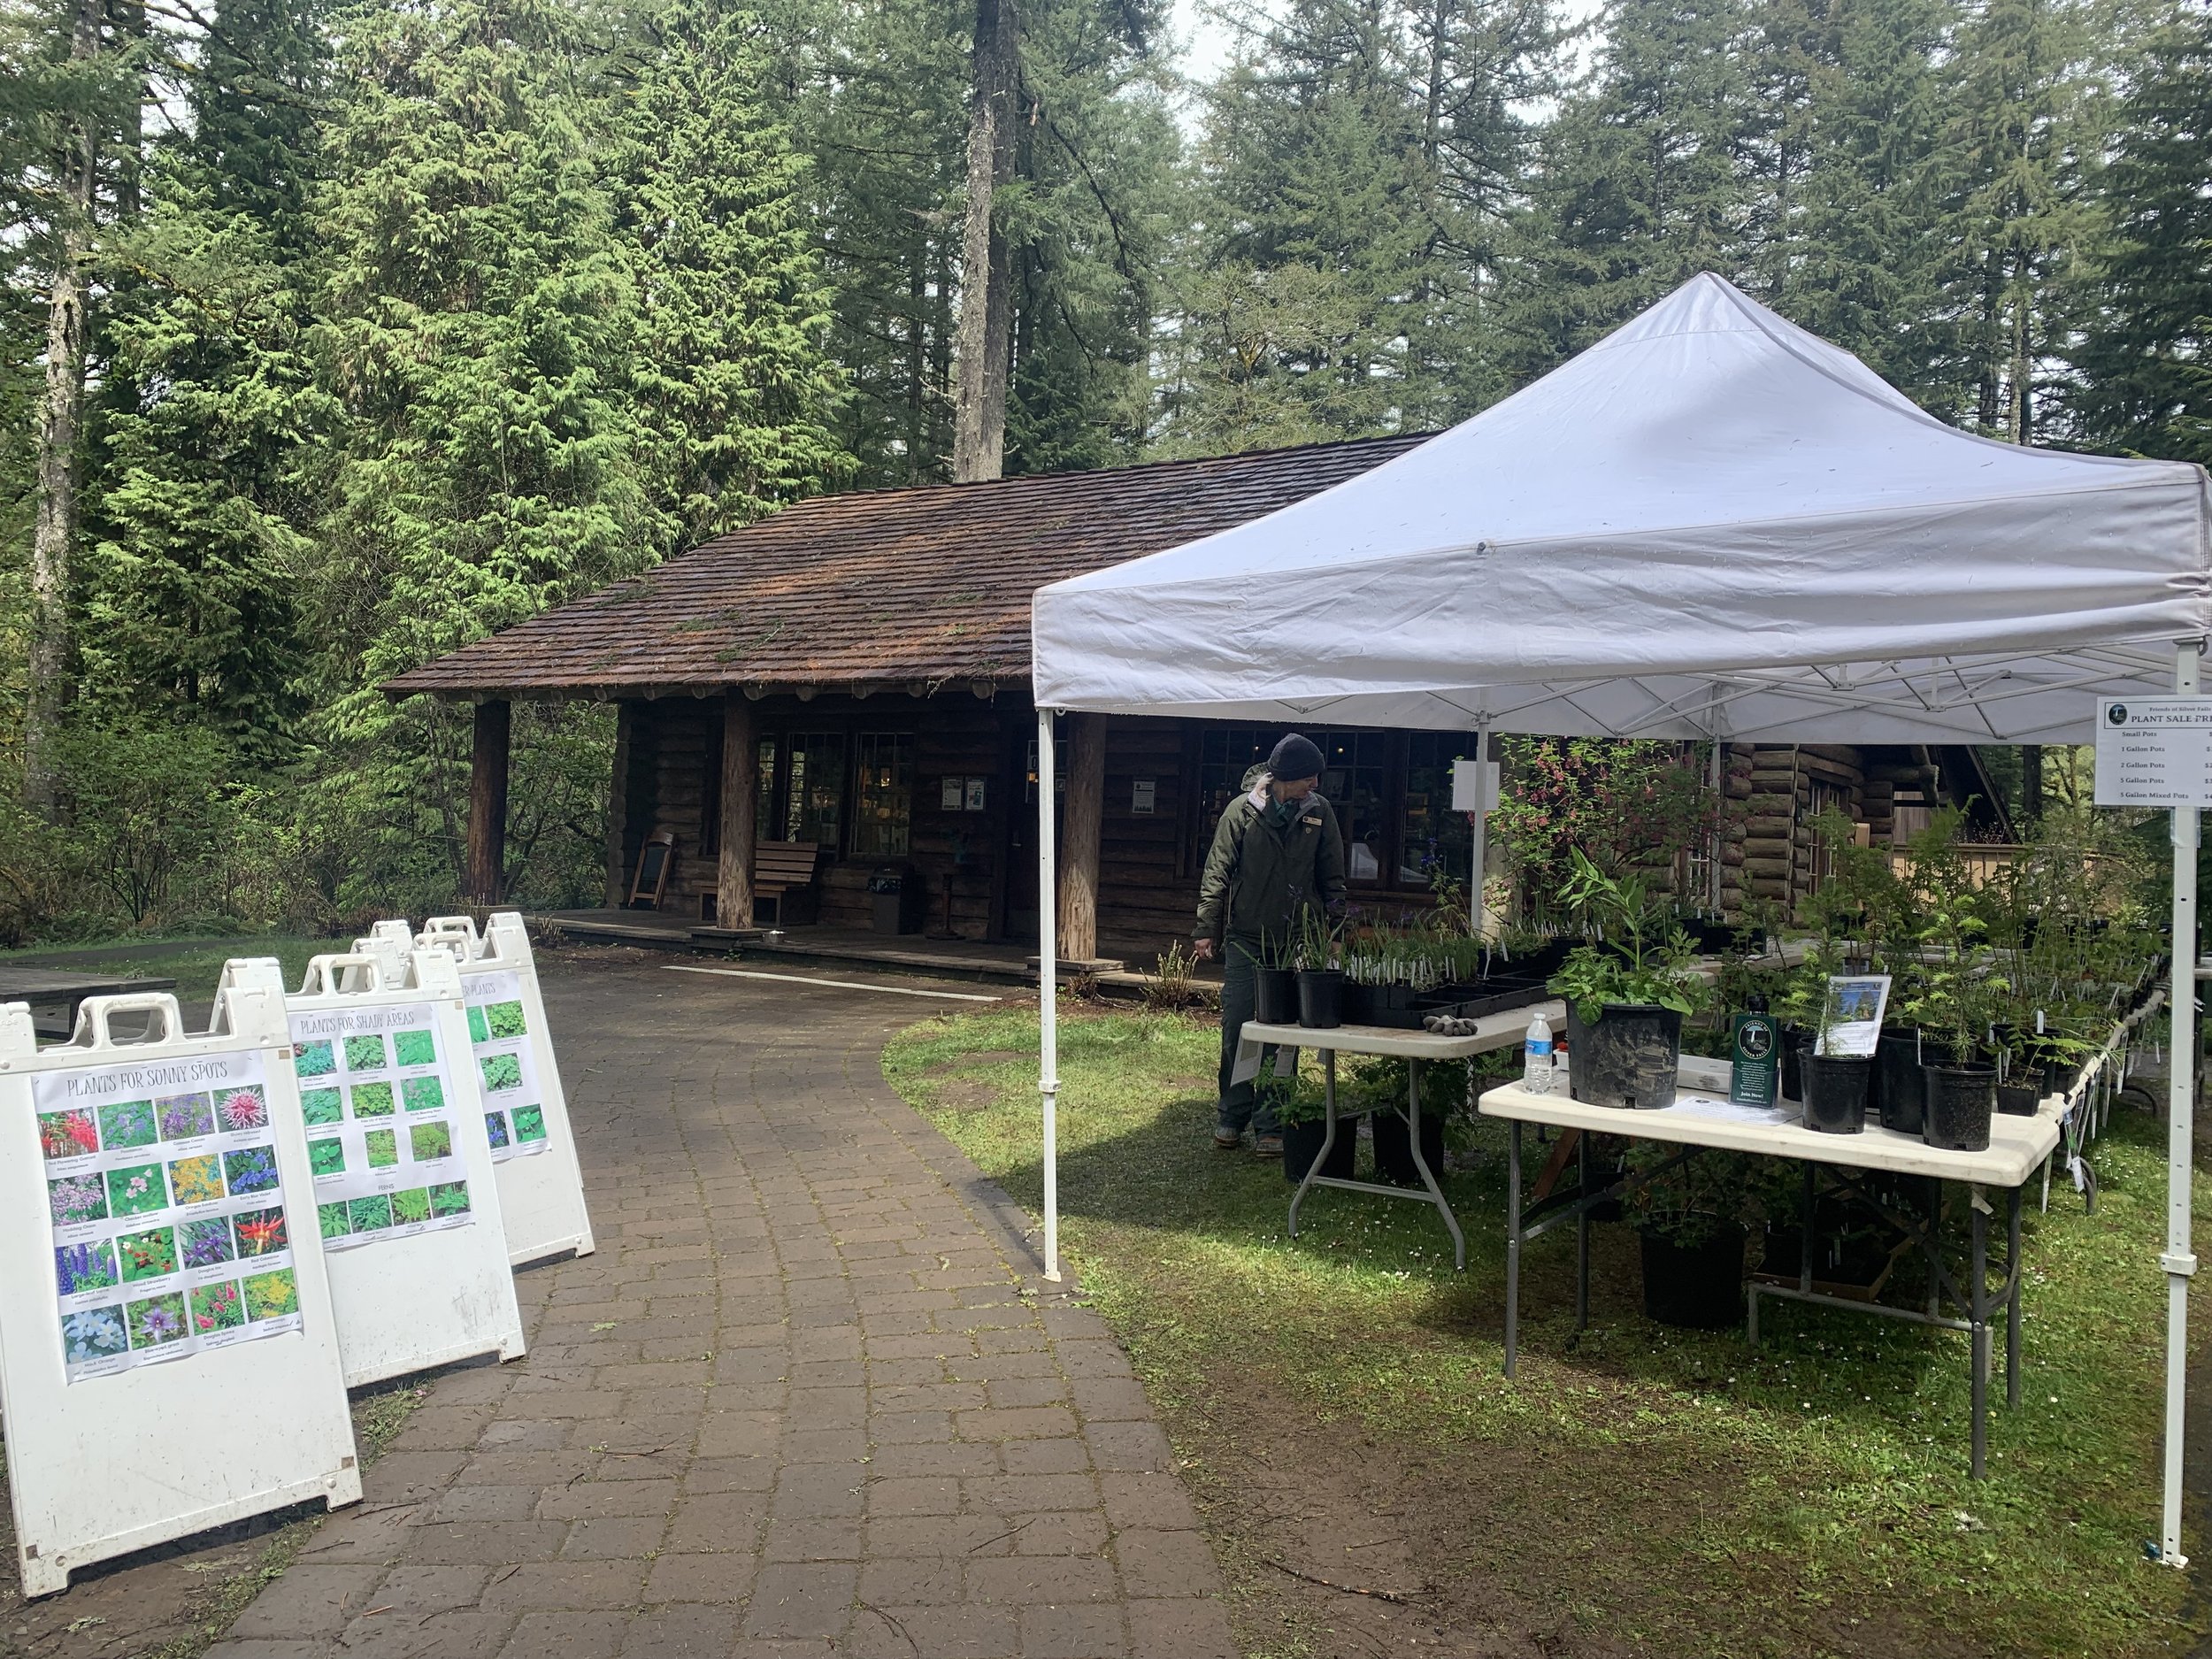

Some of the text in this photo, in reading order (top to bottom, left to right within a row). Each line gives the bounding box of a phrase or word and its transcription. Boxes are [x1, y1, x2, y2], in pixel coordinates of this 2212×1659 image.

[471, 983, 496, 996] PLANTS
[301, 1012, 414, 1034] PLANTS FOR SHADY AREAS
[67, 1061, 228, 1097] PLANTS FOR SUNNY SPOTS
